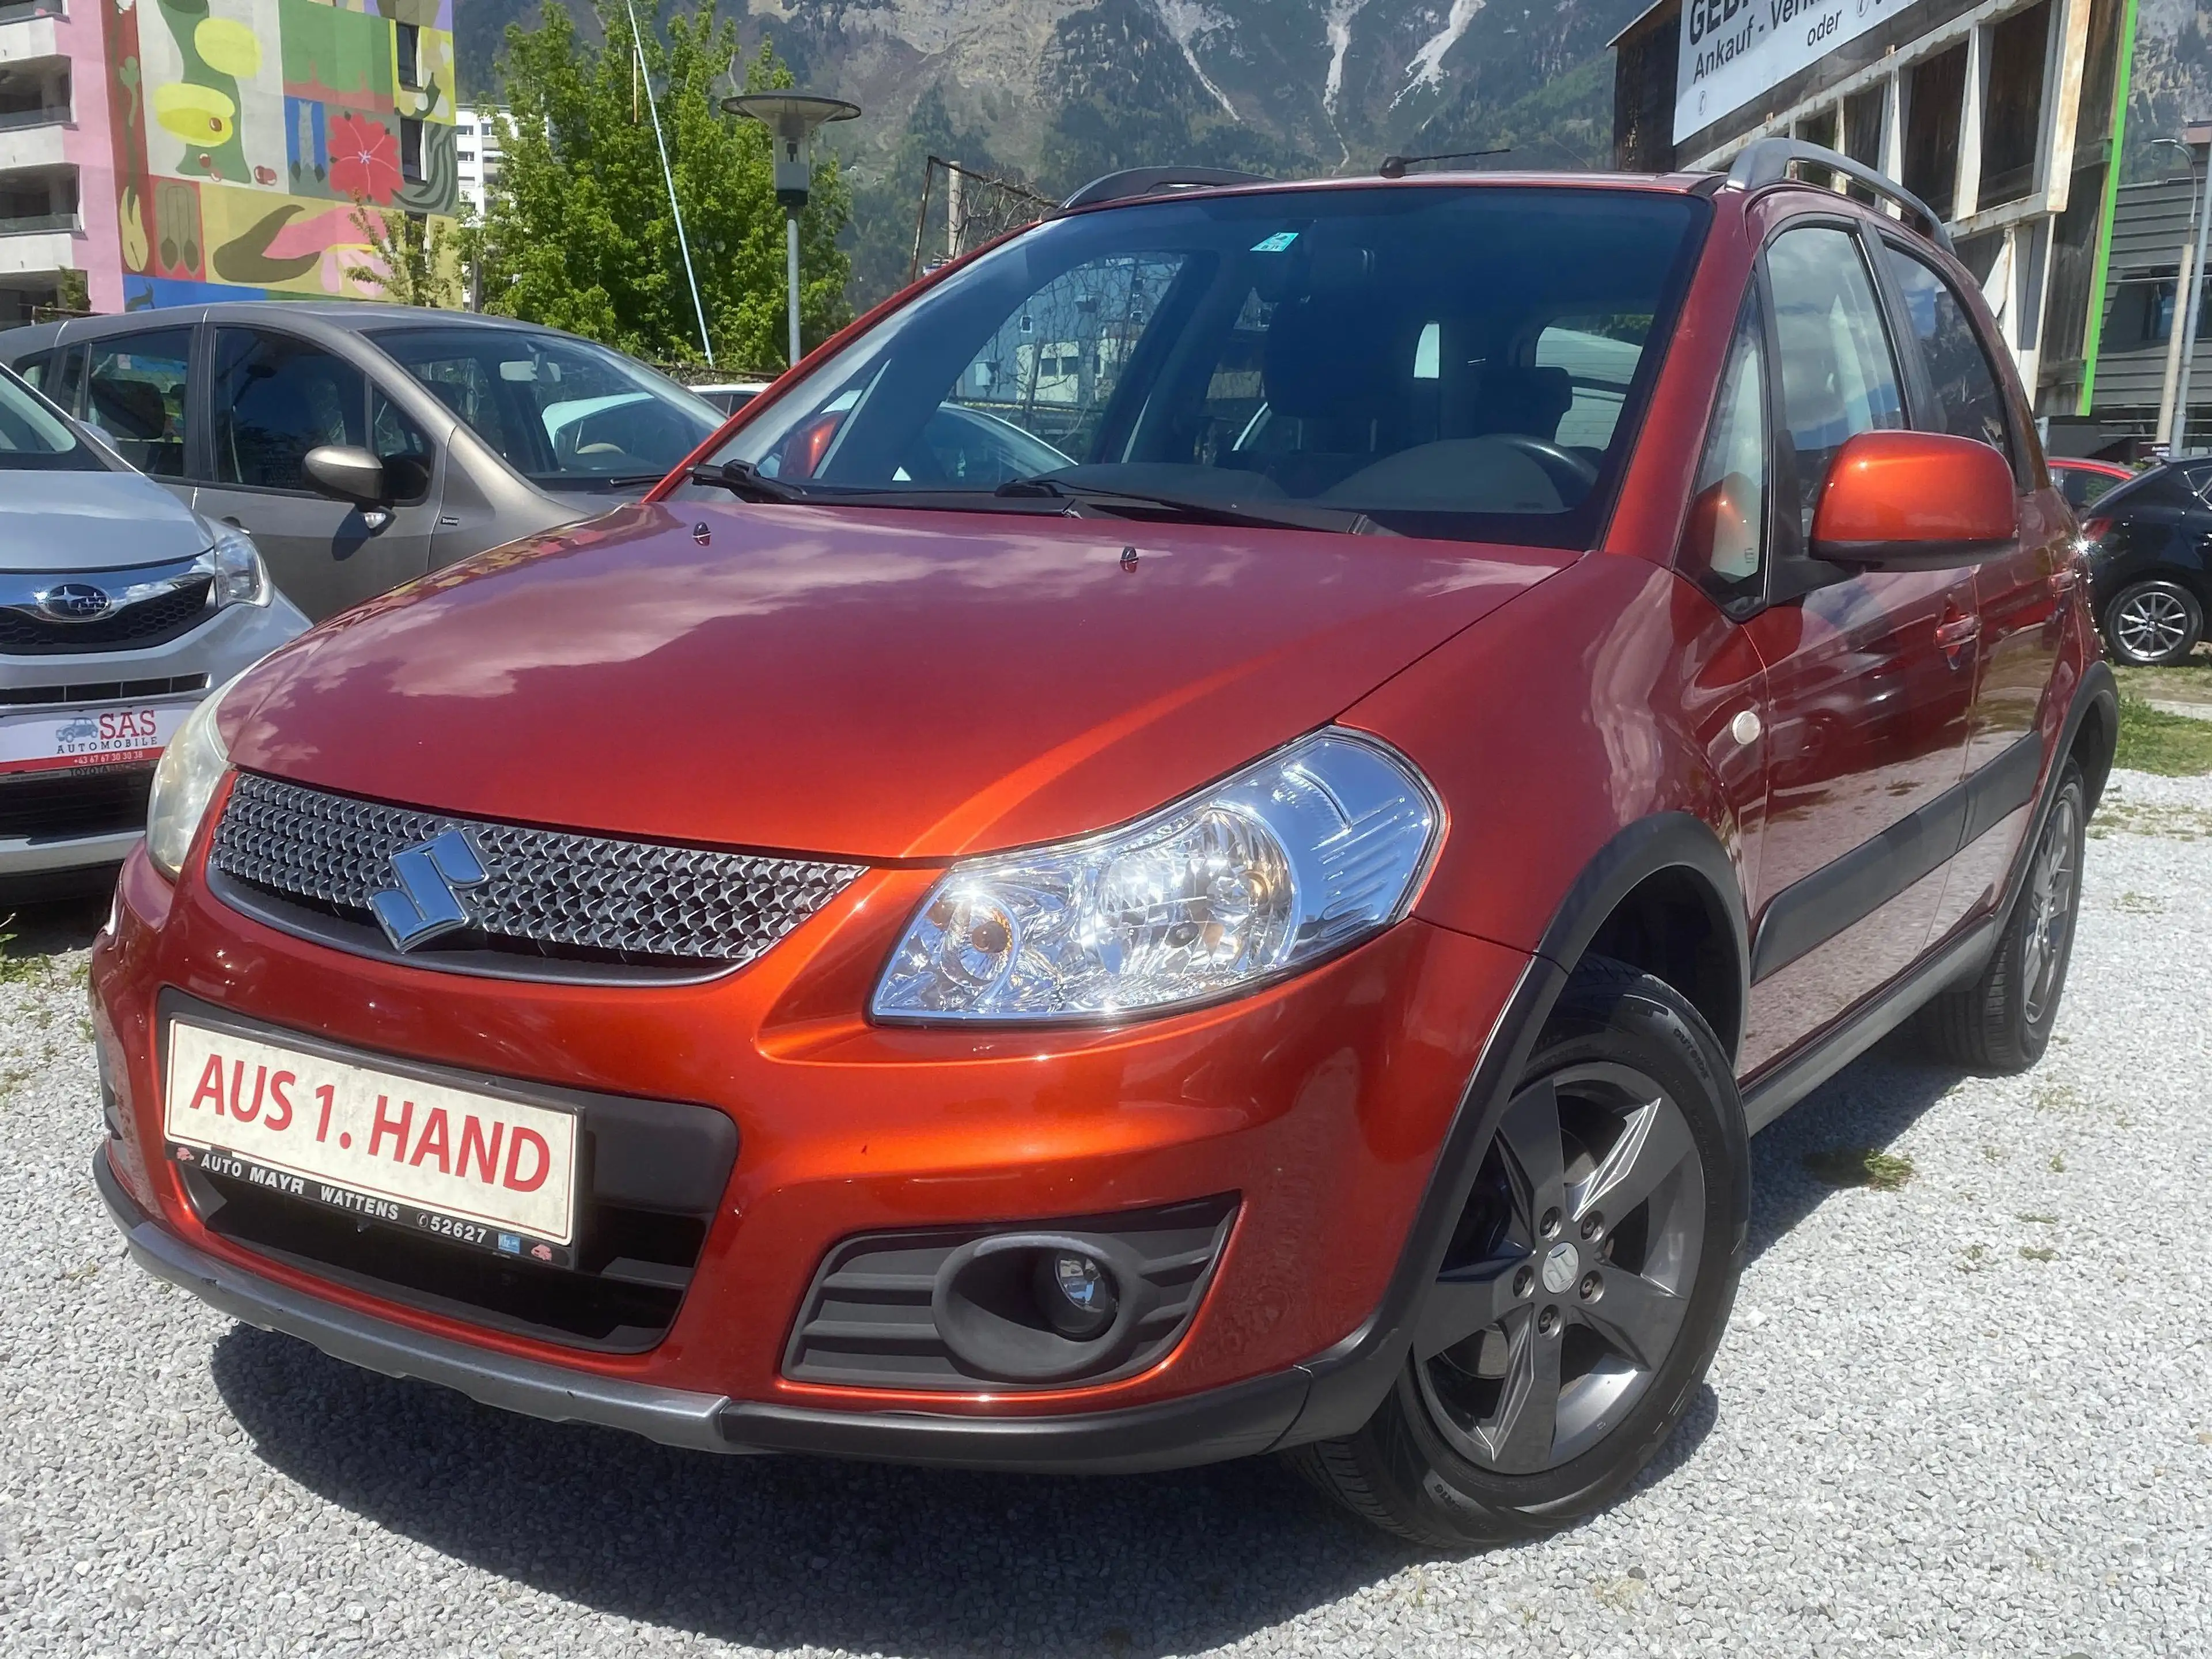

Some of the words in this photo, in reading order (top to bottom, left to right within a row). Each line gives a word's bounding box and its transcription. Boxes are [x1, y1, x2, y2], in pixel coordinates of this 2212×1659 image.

[1694, 14, 1755, 84] Ankauf
[1807, 9, 1842, 46] oder
[56, 736, 158, 754] AUTOMOBILE
[99, 710, 156, 740] SAS
[190, 1054, 296, 1131] AUS
[315, 1084, 351, 1150] 1.
[368, 1094, 550, 1193] HAND
[200, 1153, 242, 1177] AUTO
[249, 1167, 304, 1195] MAYR
[320, 1185, 400, 1221] WATTENS
[430, 1215, 488, 1244] 52627
